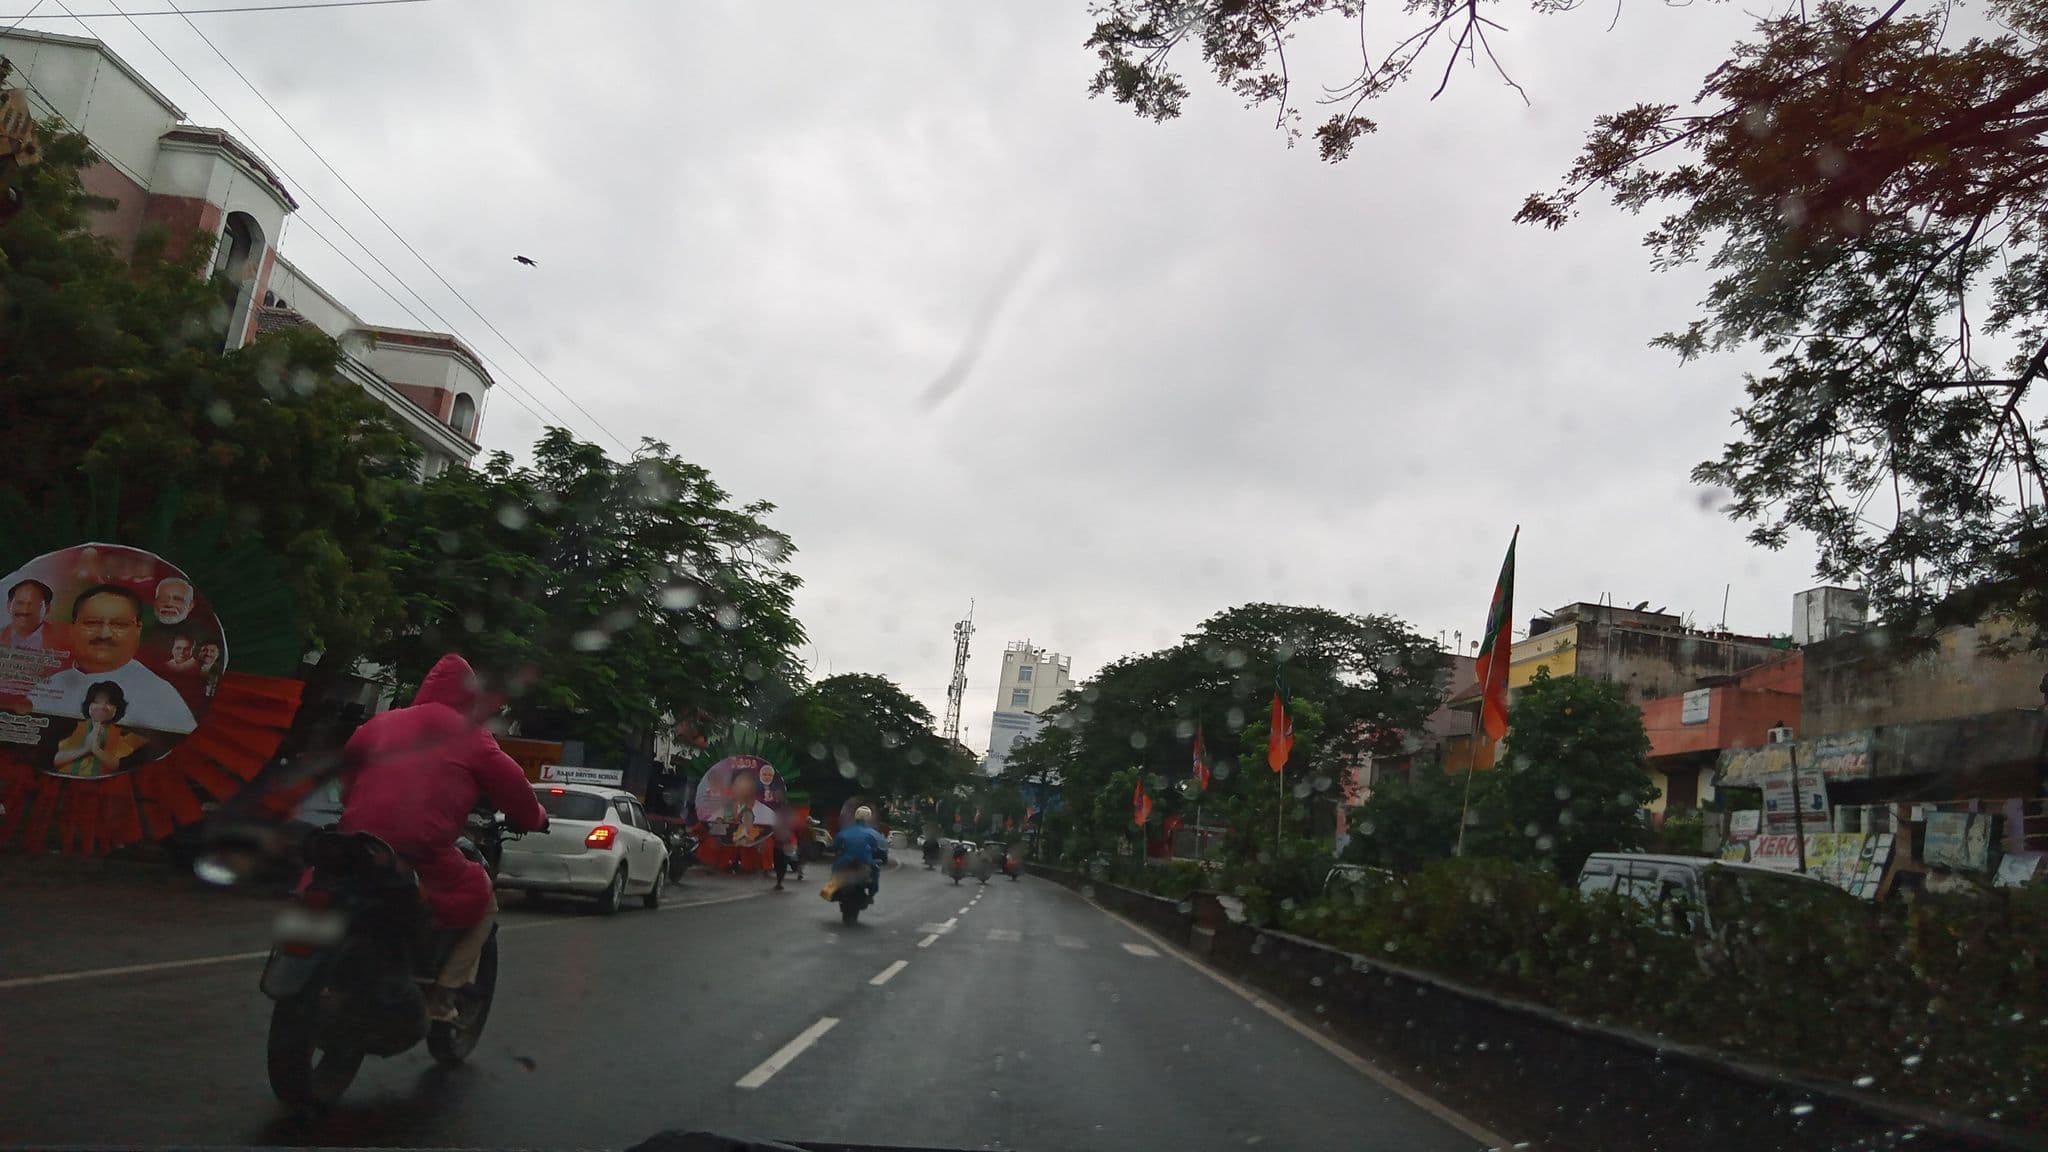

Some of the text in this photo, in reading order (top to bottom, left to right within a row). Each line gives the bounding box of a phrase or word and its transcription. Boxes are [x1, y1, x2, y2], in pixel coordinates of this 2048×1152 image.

[543, 767, 553, 778] L
[575, 771, 597, 779] DRIVING
[598, 773, 618, 781] SCHOOL
